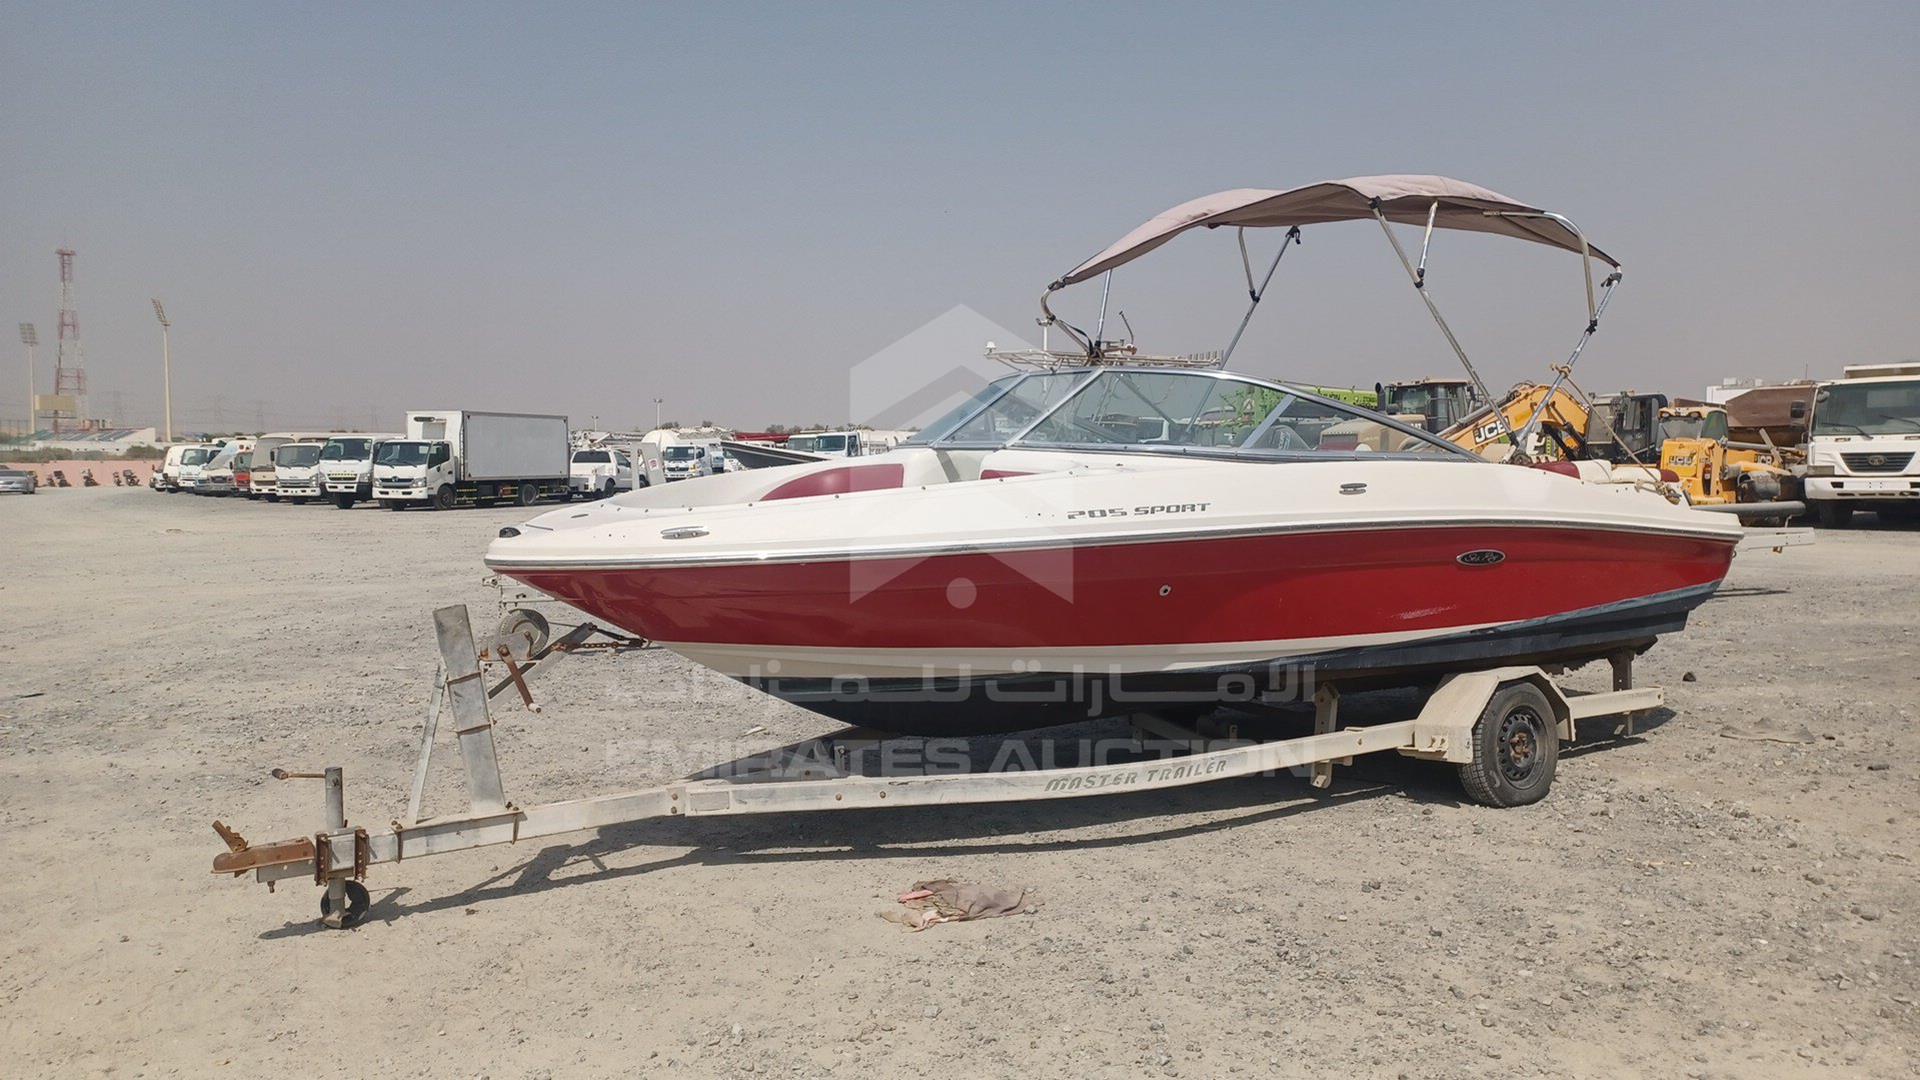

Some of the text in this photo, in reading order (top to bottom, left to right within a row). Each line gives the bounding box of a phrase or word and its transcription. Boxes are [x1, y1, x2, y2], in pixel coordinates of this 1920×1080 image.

[1066, 502, 1211, 520] 205 SPORT
[1044, 759, 1227, 792] MASTER TRAILER
